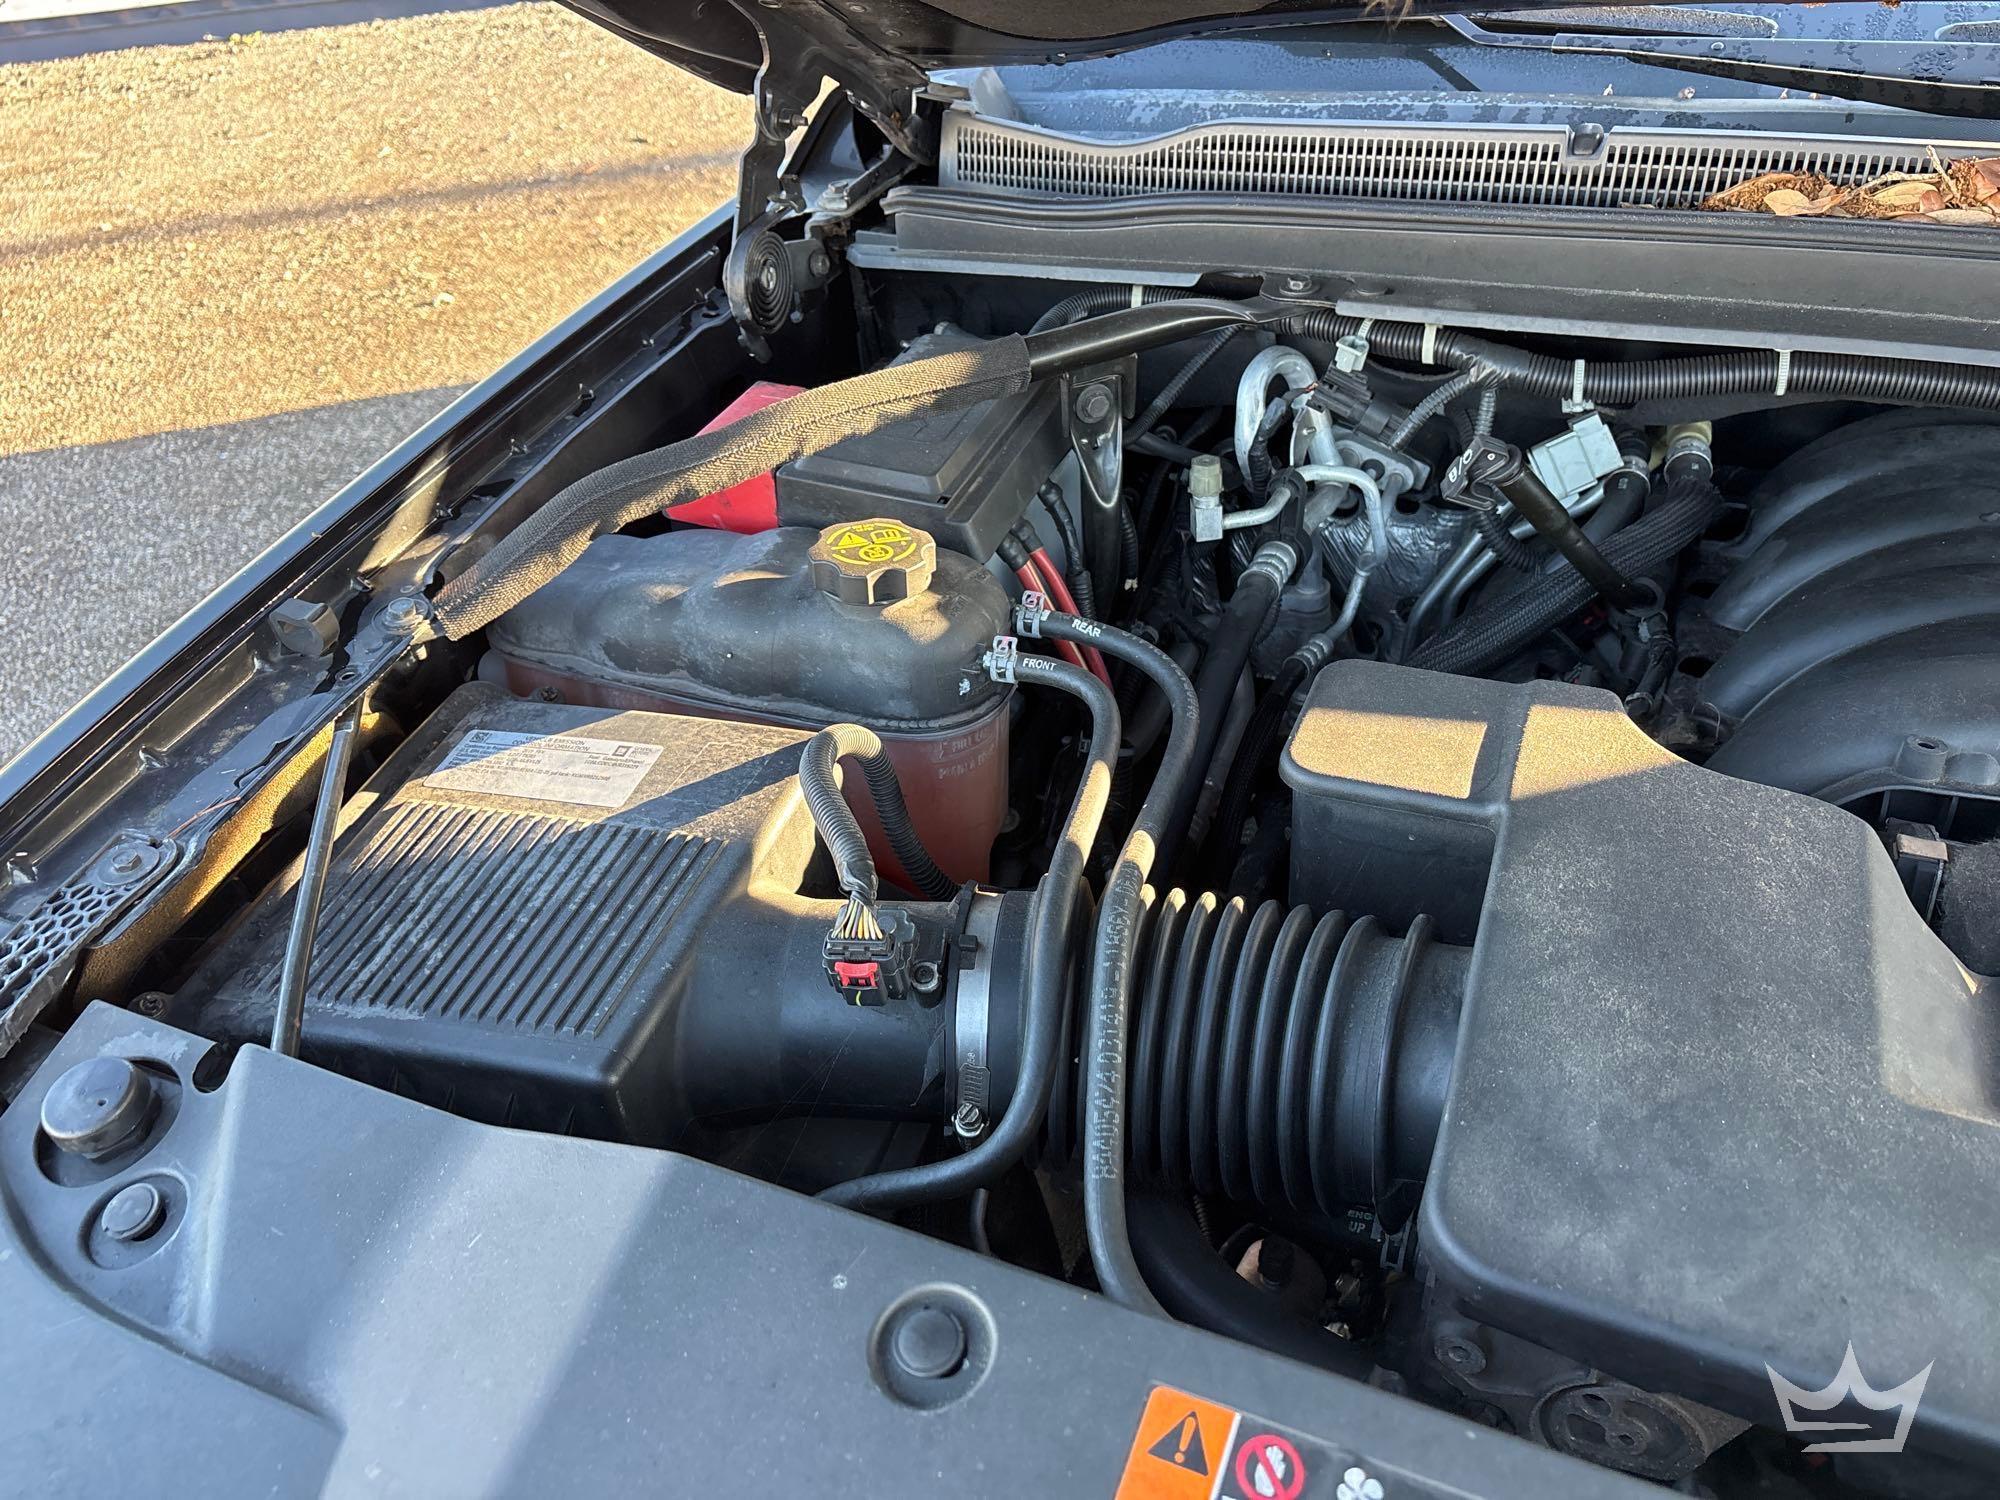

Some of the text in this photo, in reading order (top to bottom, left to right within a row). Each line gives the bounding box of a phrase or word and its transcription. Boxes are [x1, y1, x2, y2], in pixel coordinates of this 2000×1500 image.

[1071, 618, 1102, 638] REAR
[1022, 657, 1057, 671] FRONT
[1348, 1221, 1366, 1233] UP
